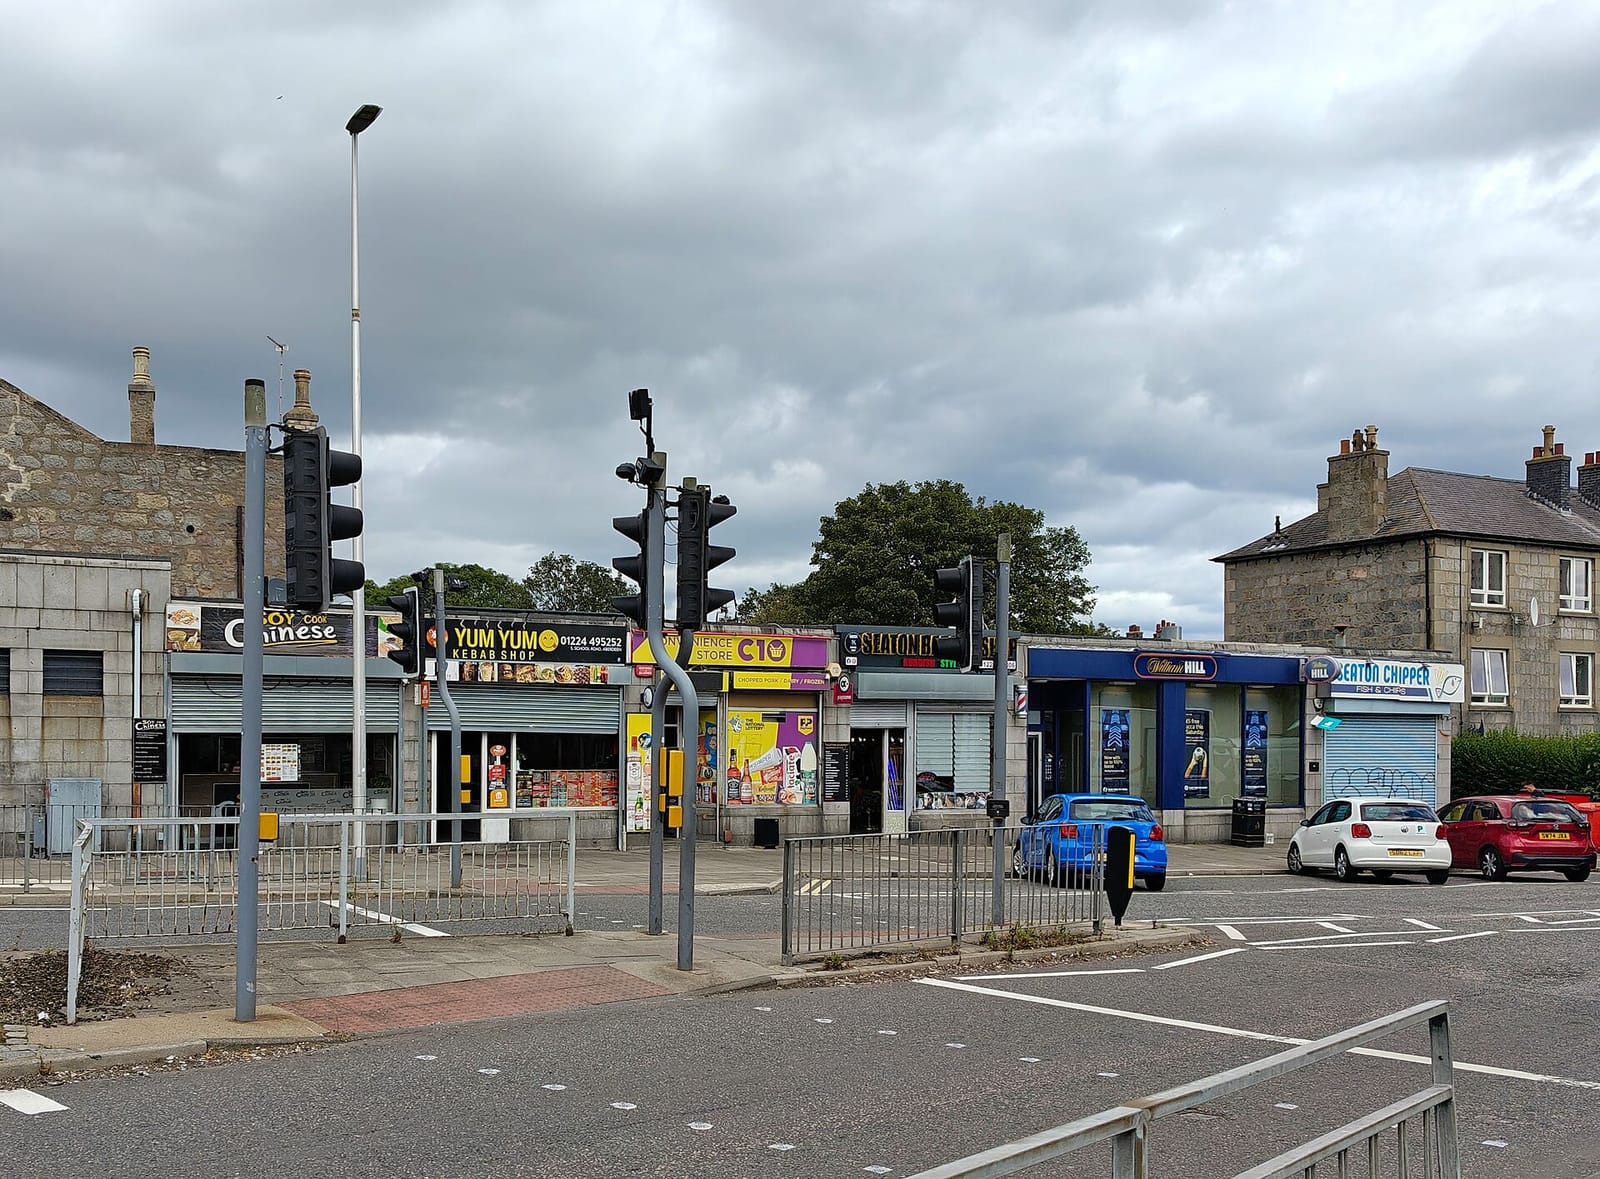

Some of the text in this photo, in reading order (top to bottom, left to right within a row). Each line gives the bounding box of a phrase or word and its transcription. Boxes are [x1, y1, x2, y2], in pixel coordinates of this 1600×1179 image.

[304, 614, 328, 624] COOK
[455, 628, 538, 650] YUM YUM
[560, 636, 622, 650] 01224 495252
[861, 632, 919, 656] SEATON
[453, 649, 536, 661] KEBAB SHOP
[697, 651, 732, 661] STORE
[1147, 657, 1206, 674] William HILL
[1311, 669, 1329, 679] HILL
[1337, 662, 1430, 686] SEATON CHIPPER
[1356, 685, 1373, 693] FISH
[1384, 686, 1406, 695] CHIPS
